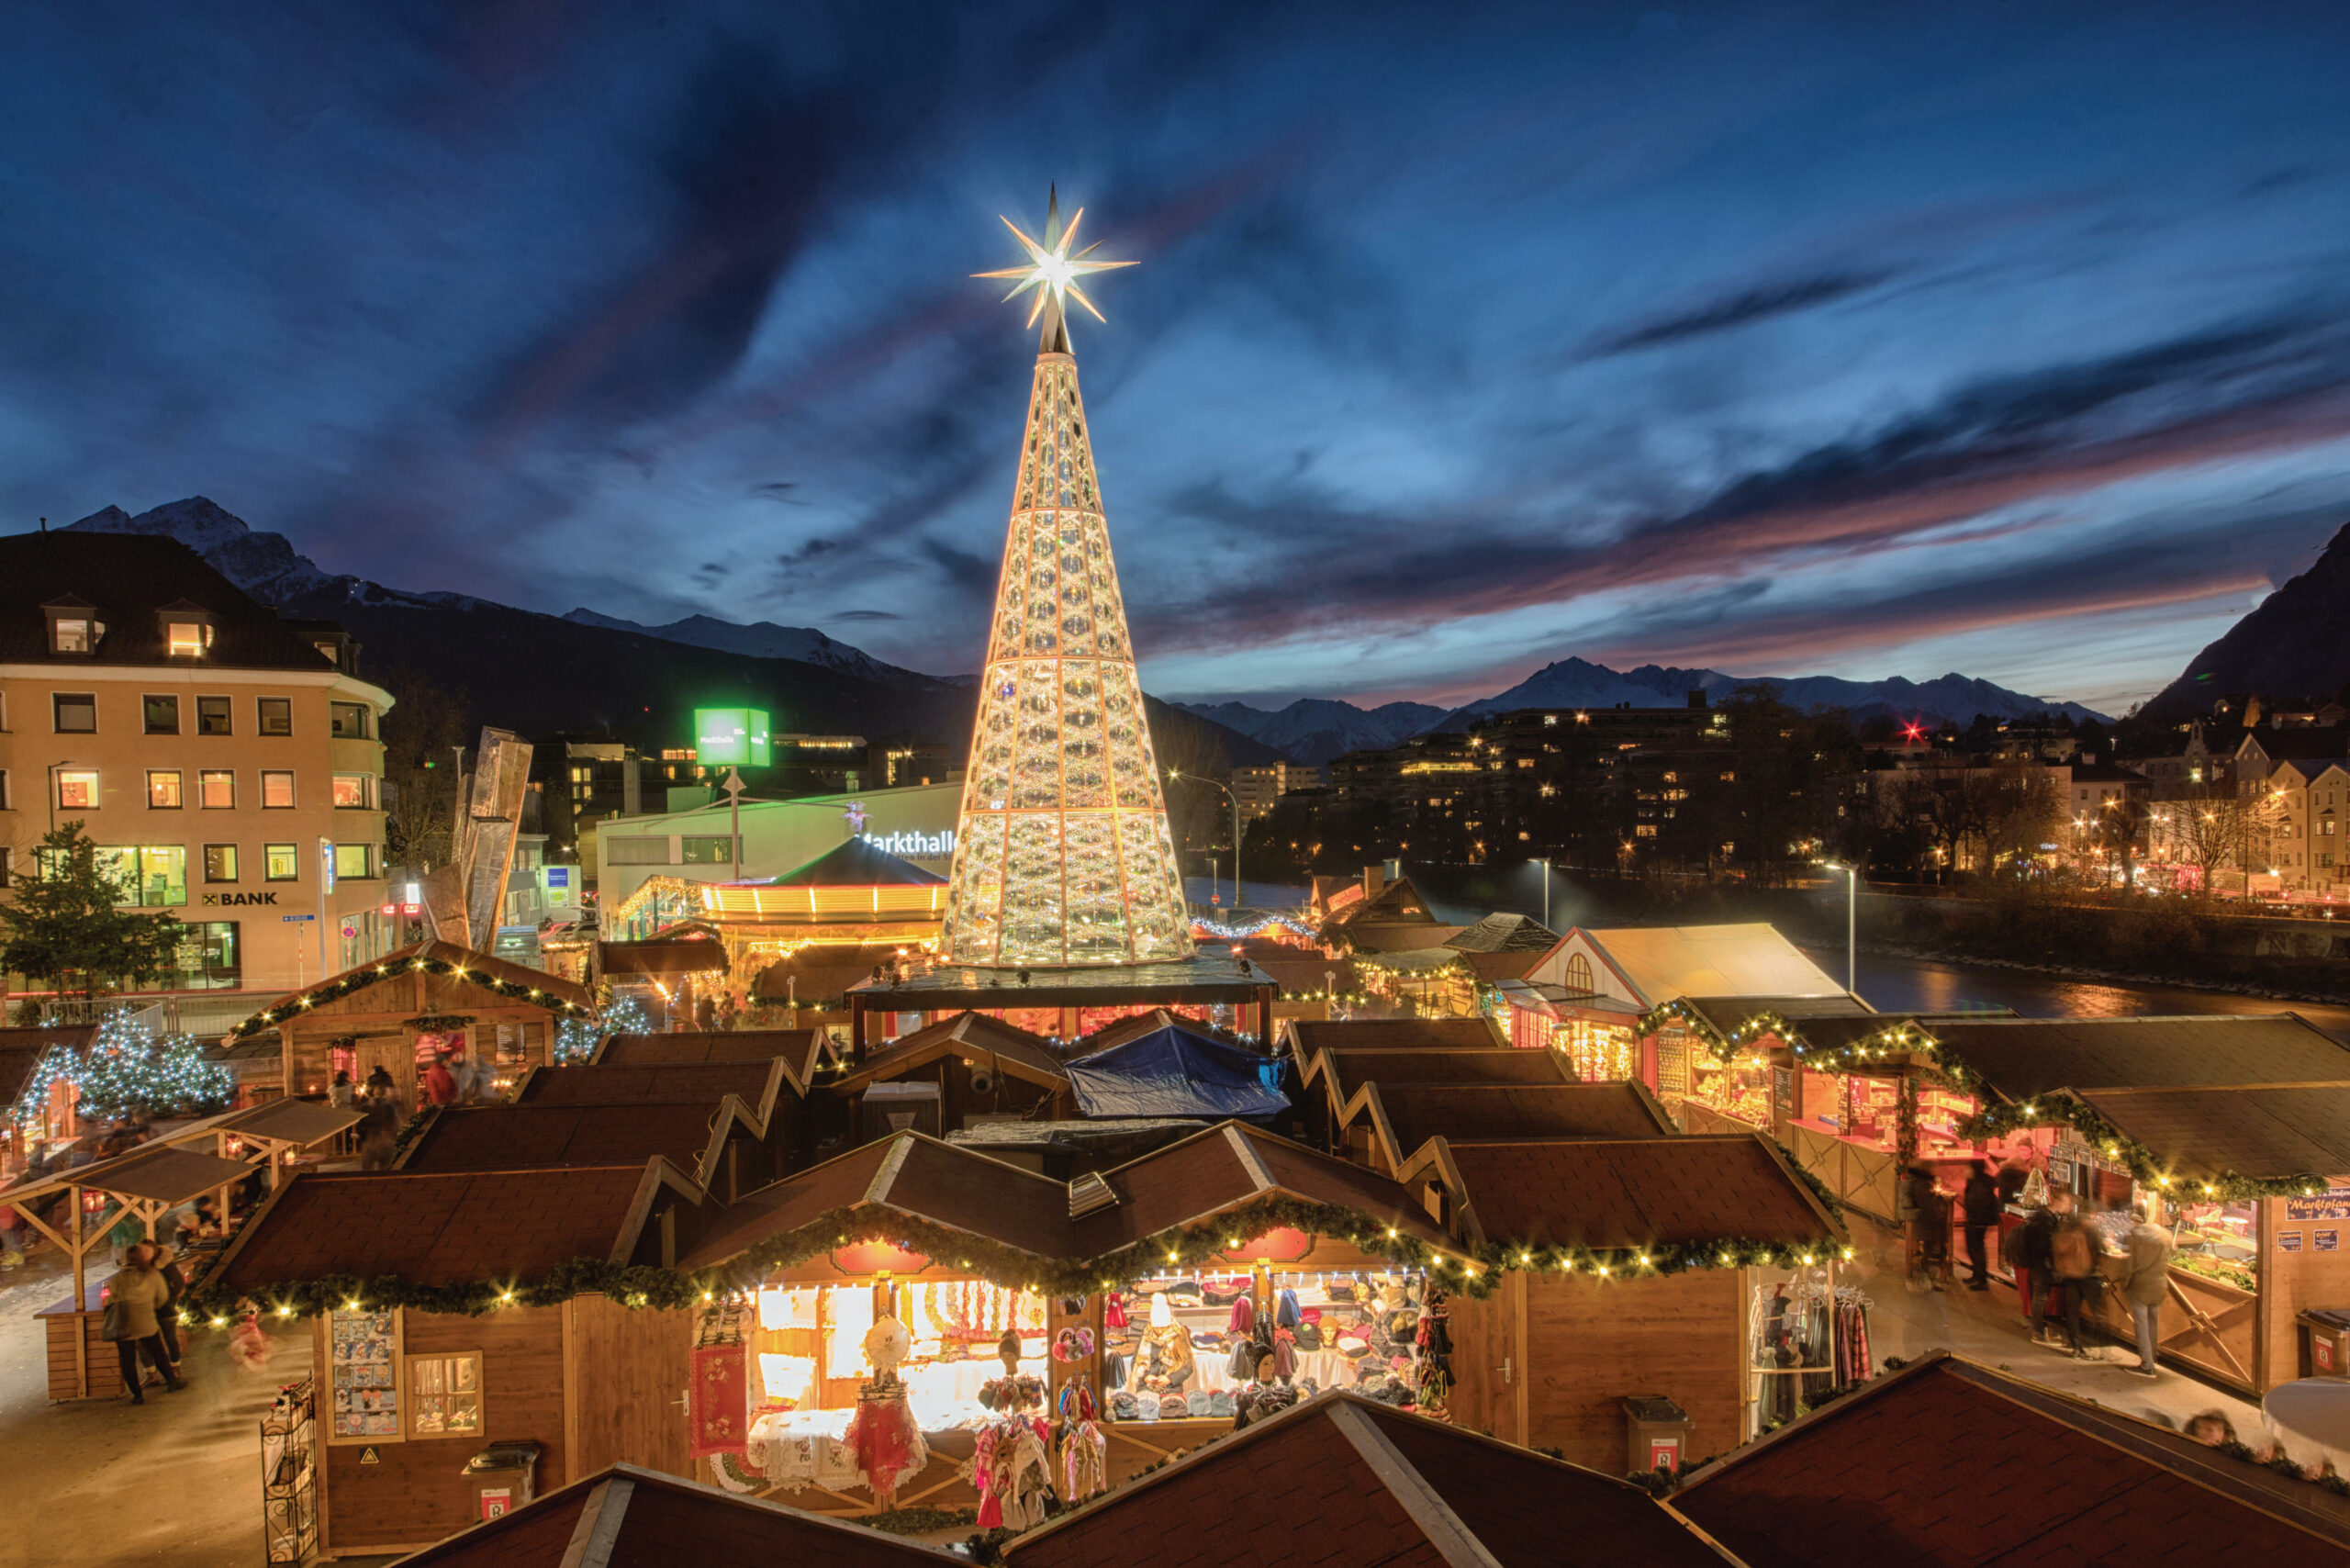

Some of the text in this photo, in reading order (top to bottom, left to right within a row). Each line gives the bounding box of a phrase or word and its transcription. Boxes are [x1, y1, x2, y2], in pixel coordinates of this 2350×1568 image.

[699, 734, 734, 745] Markthalle
[917, 852, 925, 861] in
[927, 852, 941, 861] der
[221, 892, 278, 905] BANK
[2290, 1198, 2350, 1212] Marktpfan
